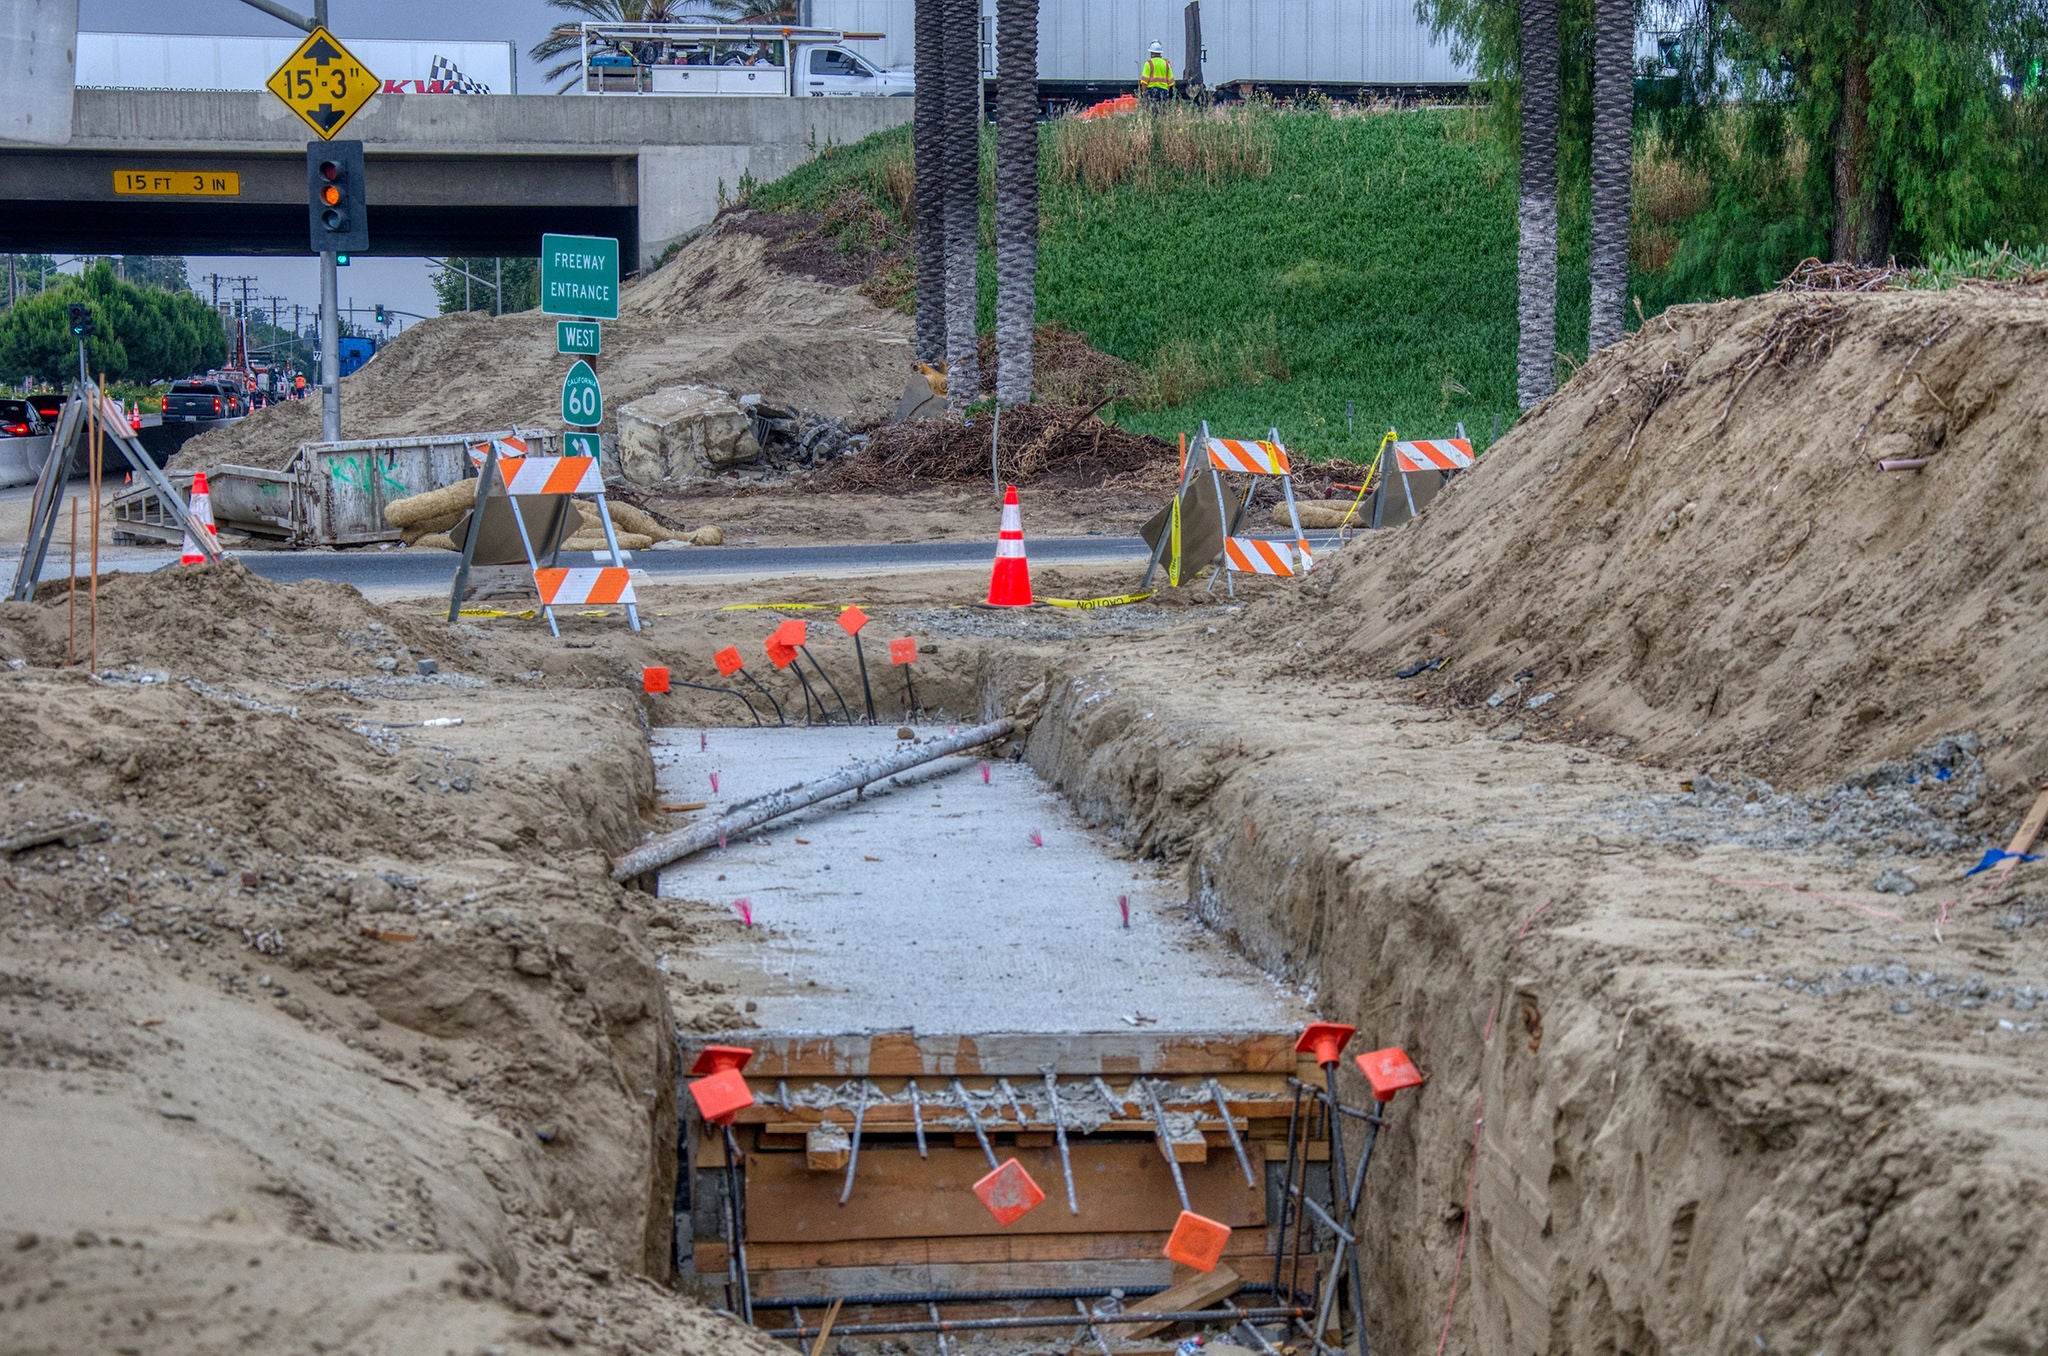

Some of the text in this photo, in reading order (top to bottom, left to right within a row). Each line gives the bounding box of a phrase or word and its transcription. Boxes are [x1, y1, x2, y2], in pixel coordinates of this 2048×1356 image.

[126, 175, 226, 191] 15 FT 3 IN
[554, 252, 606, 271] FREEWAY
[551, 281, 609, 301] ENTRANCE
[565, 327, 595, 347] WEST
[566, 376, 597, 388] CALIFORNIA
[569, 386, 596, 416] 60
